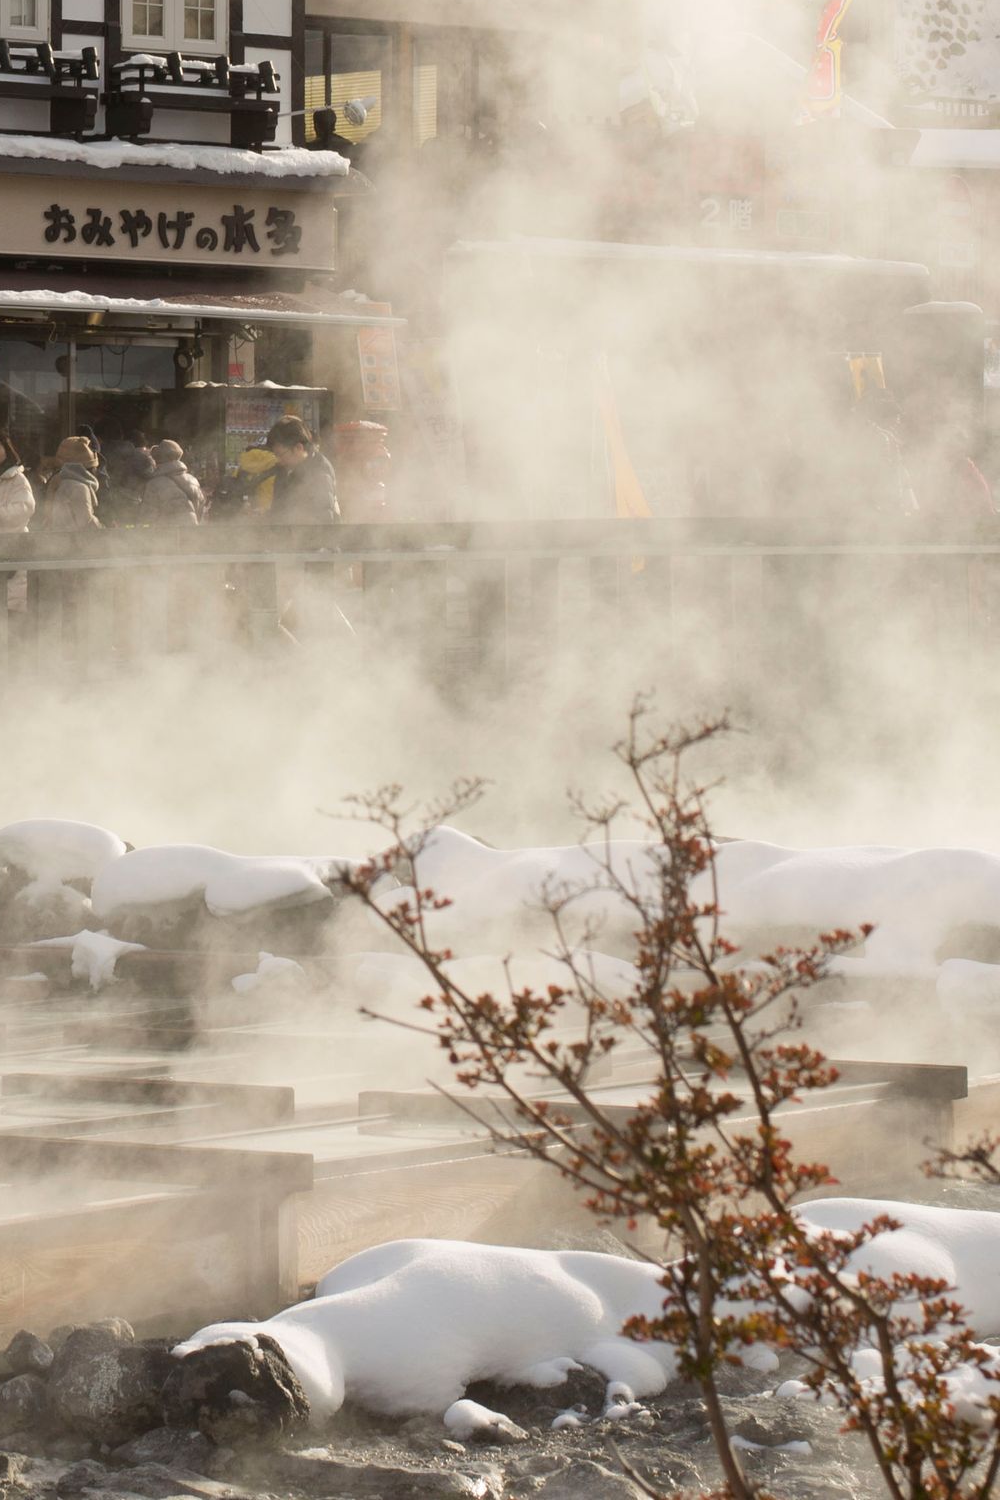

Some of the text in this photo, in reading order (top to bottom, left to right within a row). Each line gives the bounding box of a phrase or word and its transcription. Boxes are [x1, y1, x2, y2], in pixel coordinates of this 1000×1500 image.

[44, 203, 303, 256] おみやげの本多
